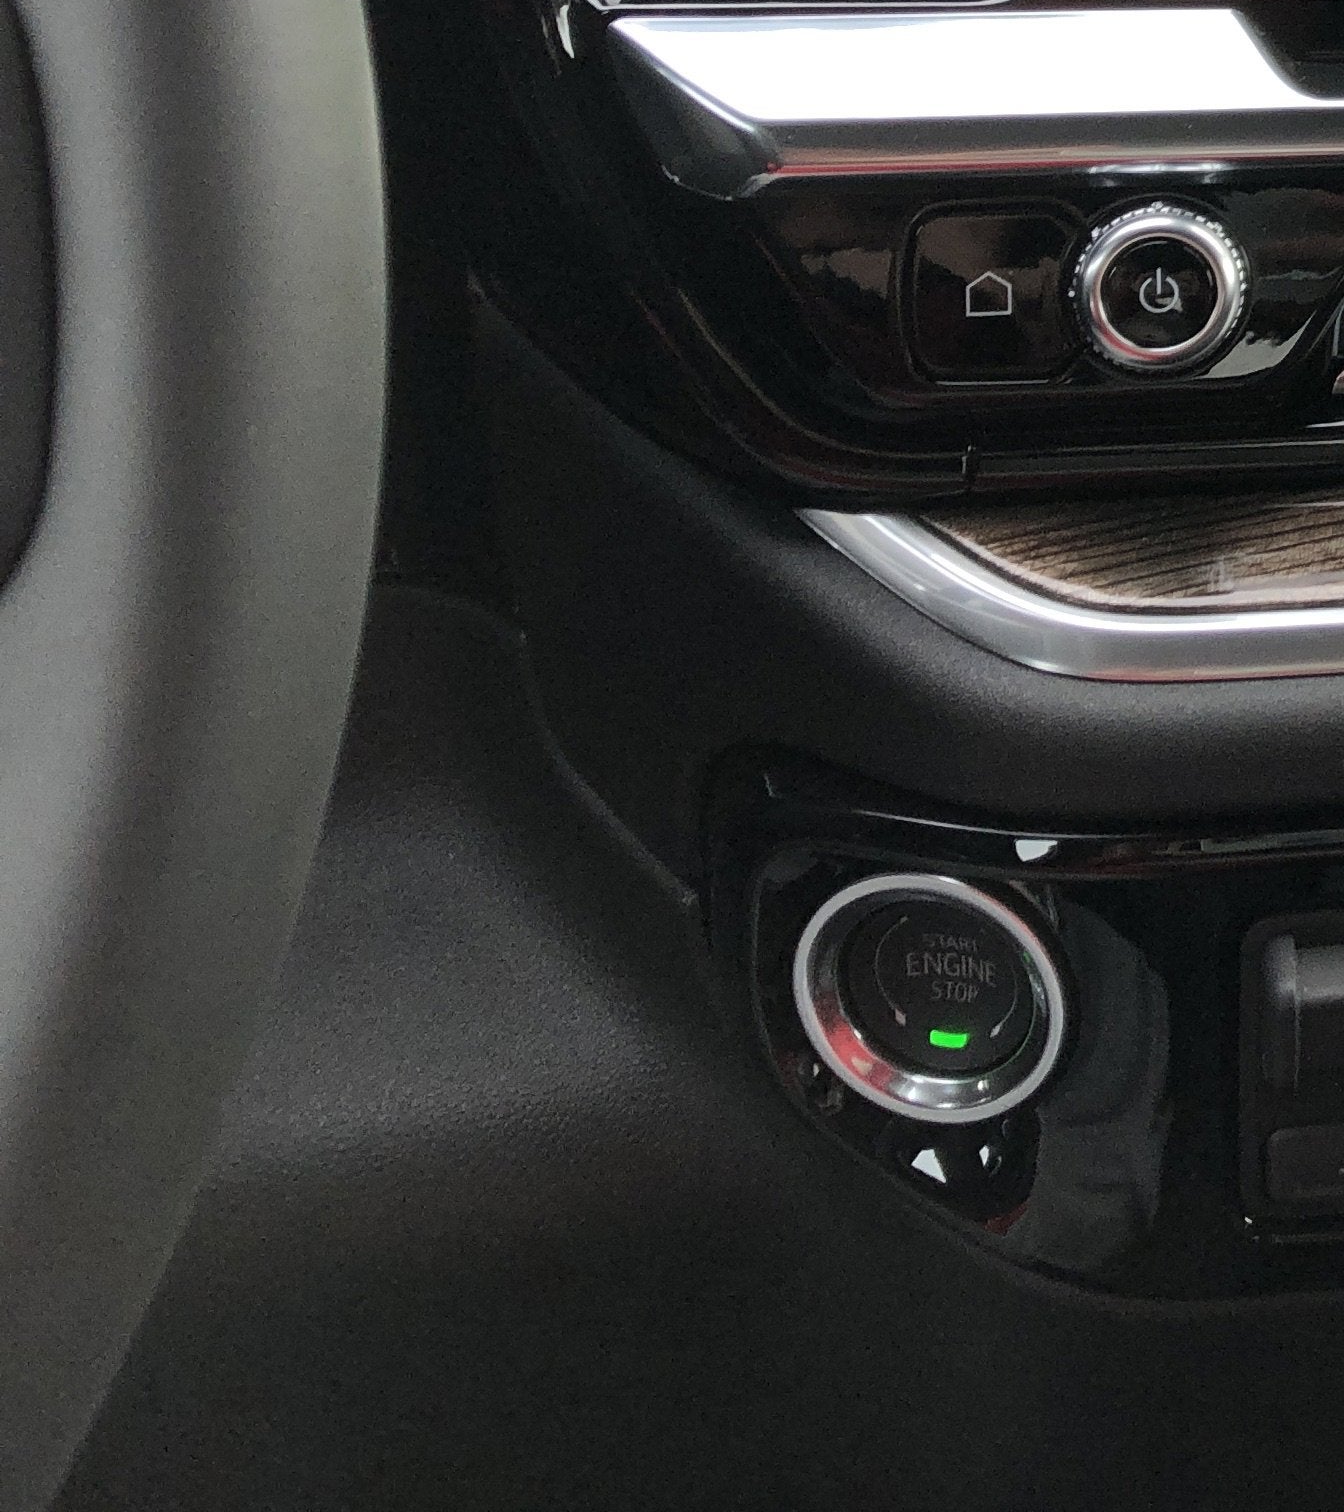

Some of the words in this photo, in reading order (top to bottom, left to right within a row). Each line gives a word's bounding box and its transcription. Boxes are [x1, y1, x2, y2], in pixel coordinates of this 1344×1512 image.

[922, 933, 977, 953] START
[906, 952, 998, 988] ENGINE
[931, 980, 979, 1003] STOP
